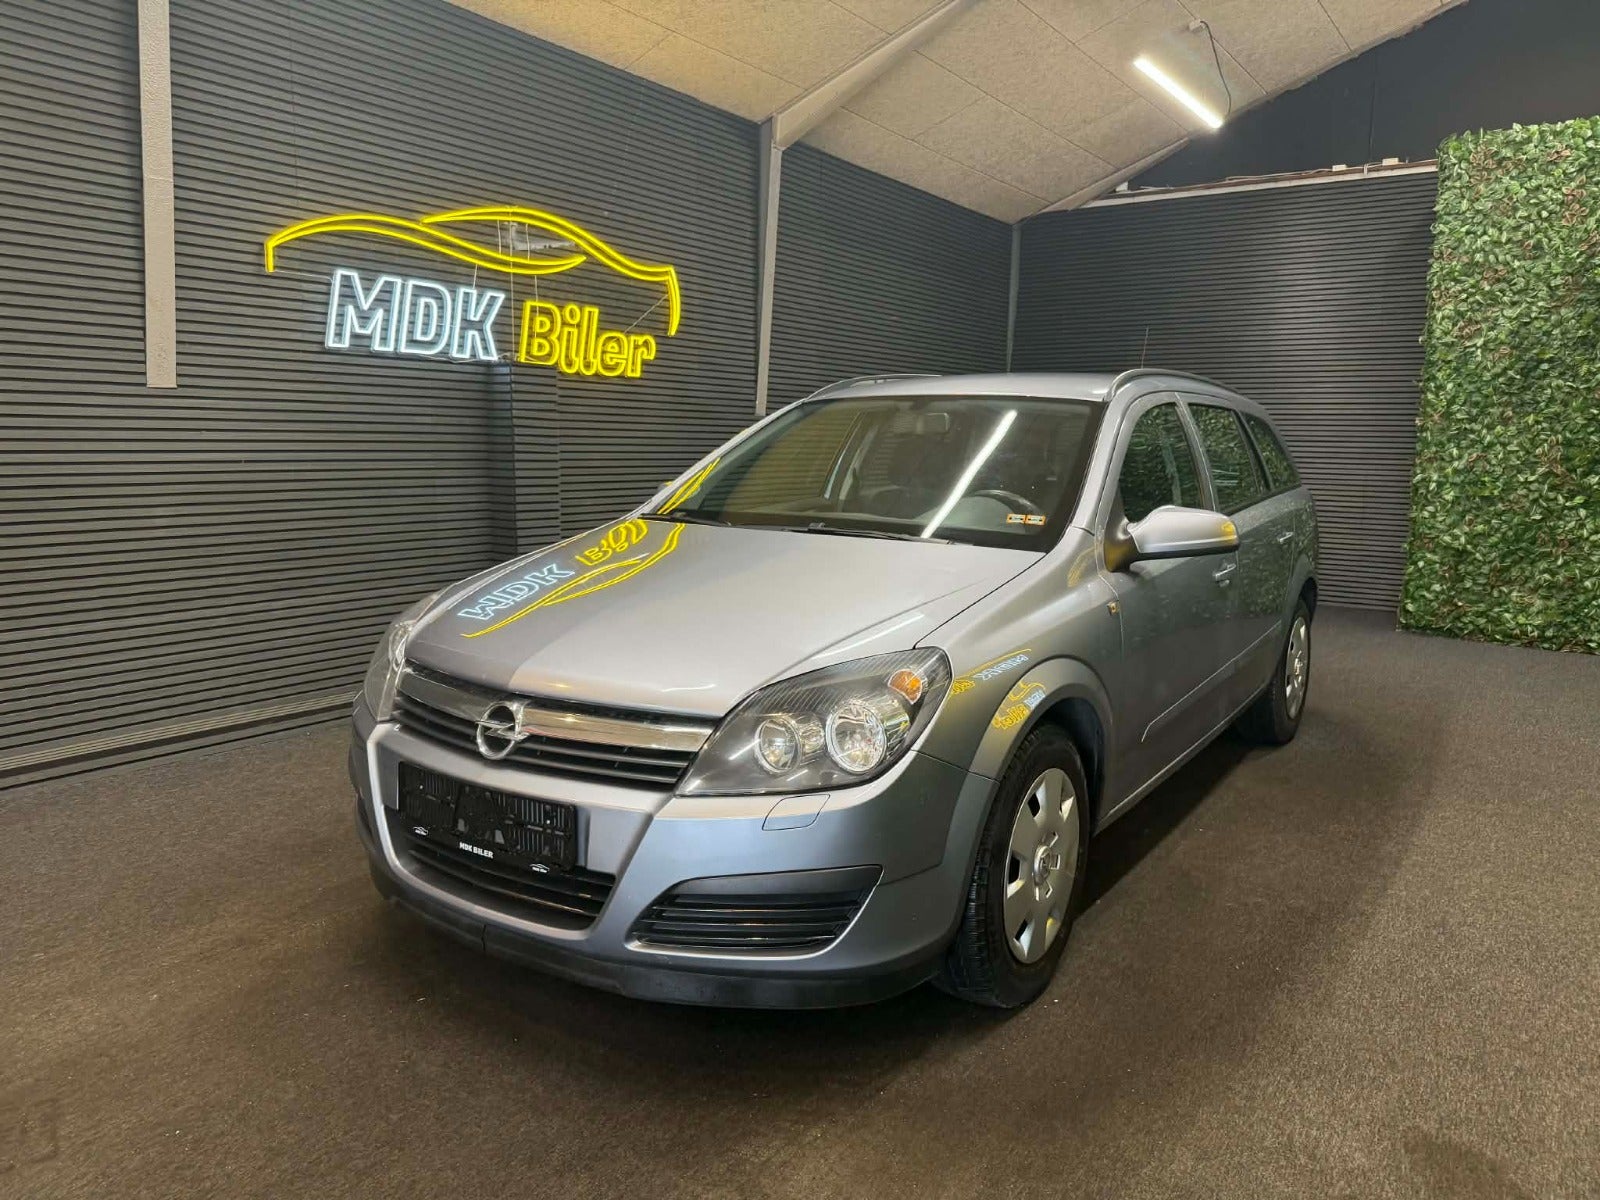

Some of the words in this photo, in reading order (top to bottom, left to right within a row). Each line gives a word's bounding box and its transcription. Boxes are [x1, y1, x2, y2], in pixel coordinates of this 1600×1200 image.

[325, 269, 505, 363] MDK
[516, 300, 657, 378] Biler
[459, 841, 473, 852] MDK
[473, 846, 494, 859] BILER
